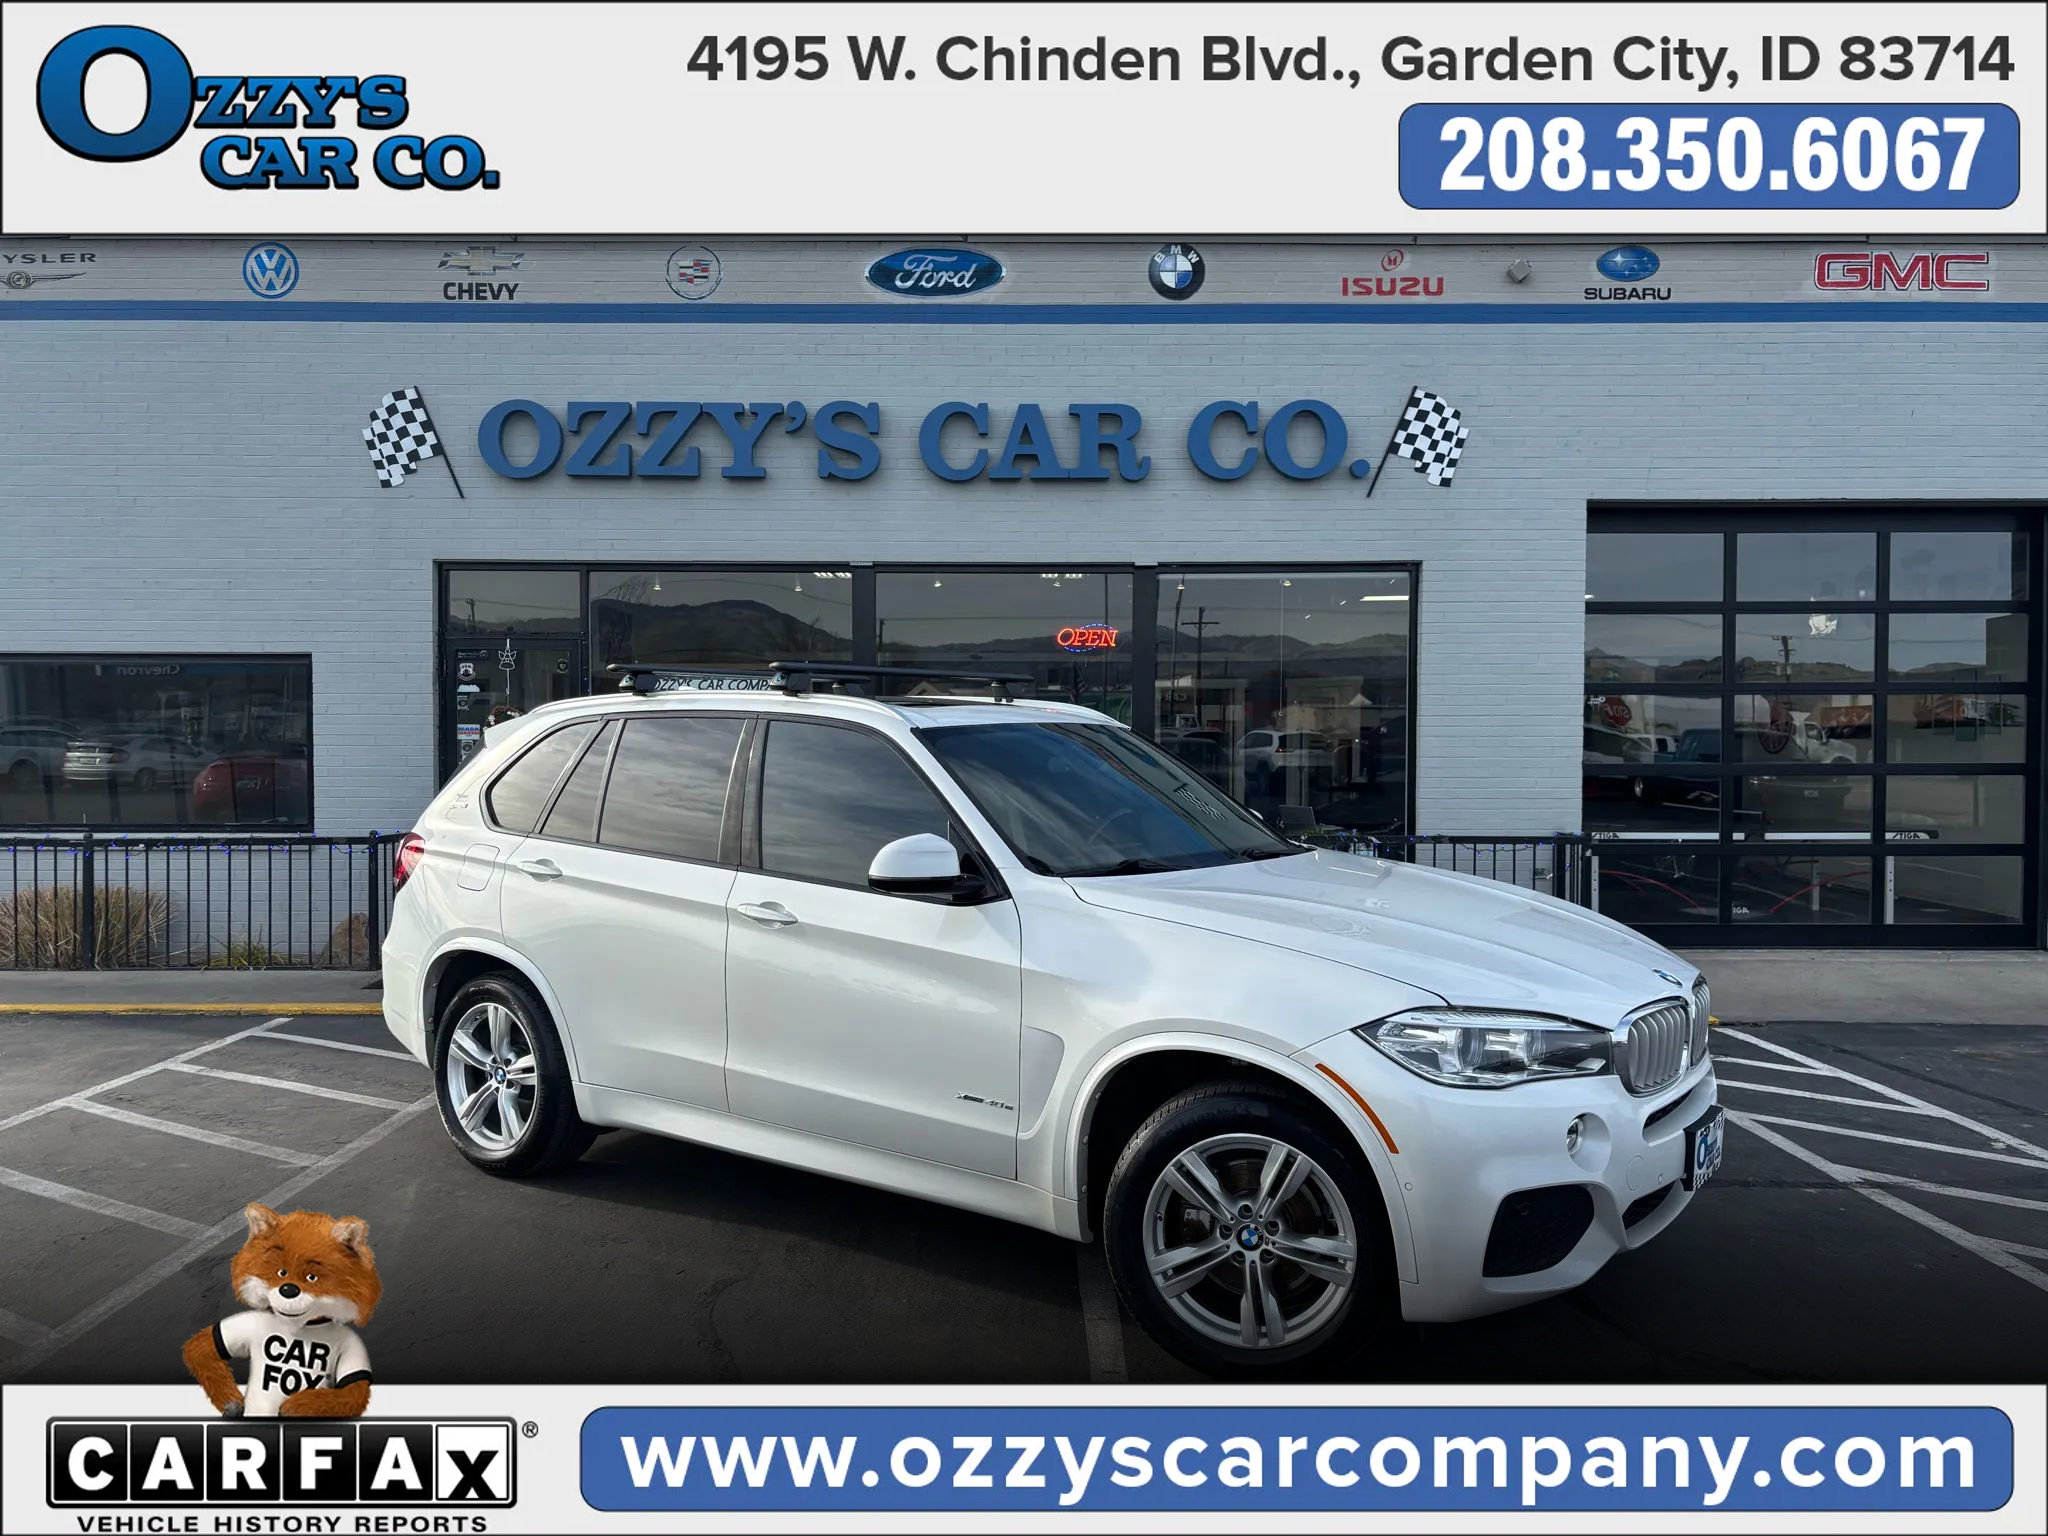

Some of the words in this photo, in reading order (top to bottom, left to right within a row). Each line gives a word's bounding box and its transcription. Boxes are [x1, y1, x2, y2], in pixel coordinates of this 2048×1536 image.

[1154, 245, 1199, 264] BMW
[894, 253, 978, 289] Ford
[1814, 252, 1990, 291] GMC
[443, 282, 519, 301] CHEVY
[1342, 277, 1444, 296] ISUZU
[1584, 287, 1672, 301] SUBARU
[478, 399, 881, 480] OZZY'S
[919, 401, 1152, 481] CAR
[1187, 399, 1371, 480] CO.
[1057, 628, 1119, 647] OPEN
[698, 679, 723, 690] CAR
